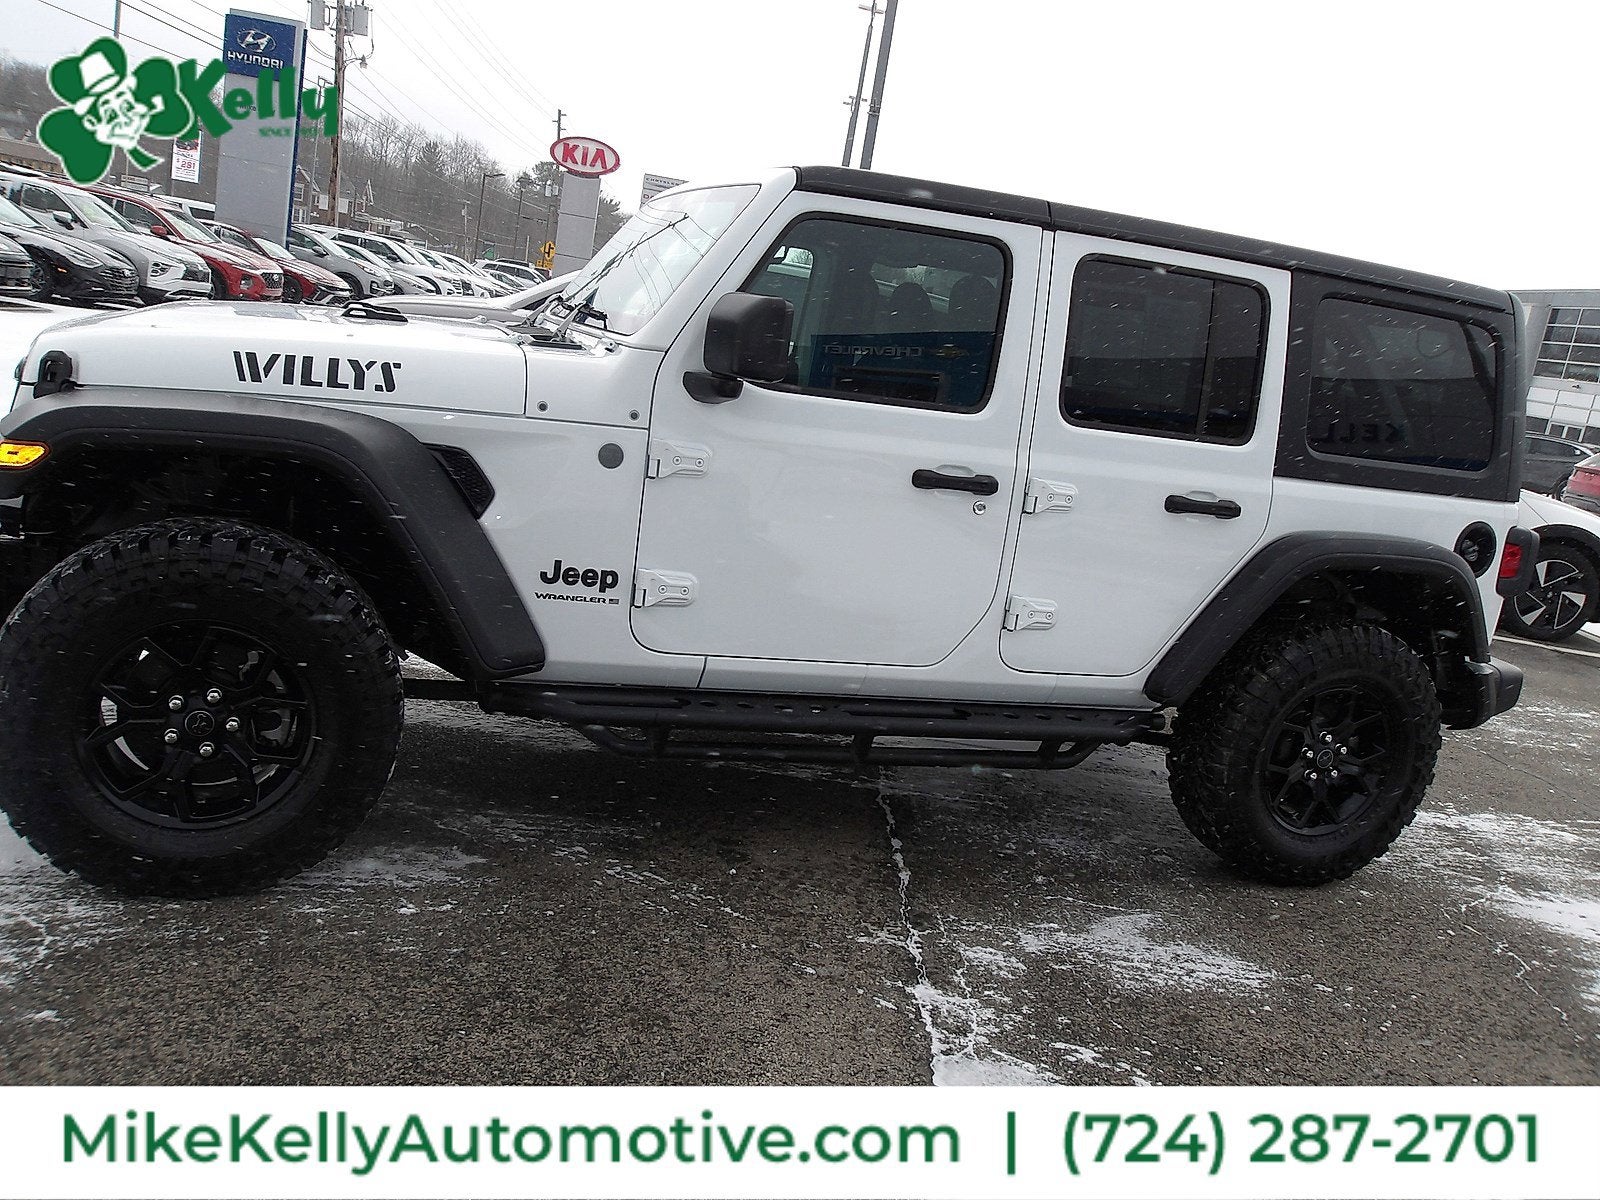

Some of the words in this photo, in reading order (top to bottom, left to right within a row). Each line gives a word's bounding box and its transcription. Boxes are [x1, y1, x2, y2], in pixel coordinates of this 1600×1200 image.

[227, 50, 284, 70] HYUNDAI
[561, 142, 608, 170] KIA
[233, 350, 402, 393] WILLYS
[539, 559, 619, 594] Jeep
[534, 592, 607, 604] WRANGLER
